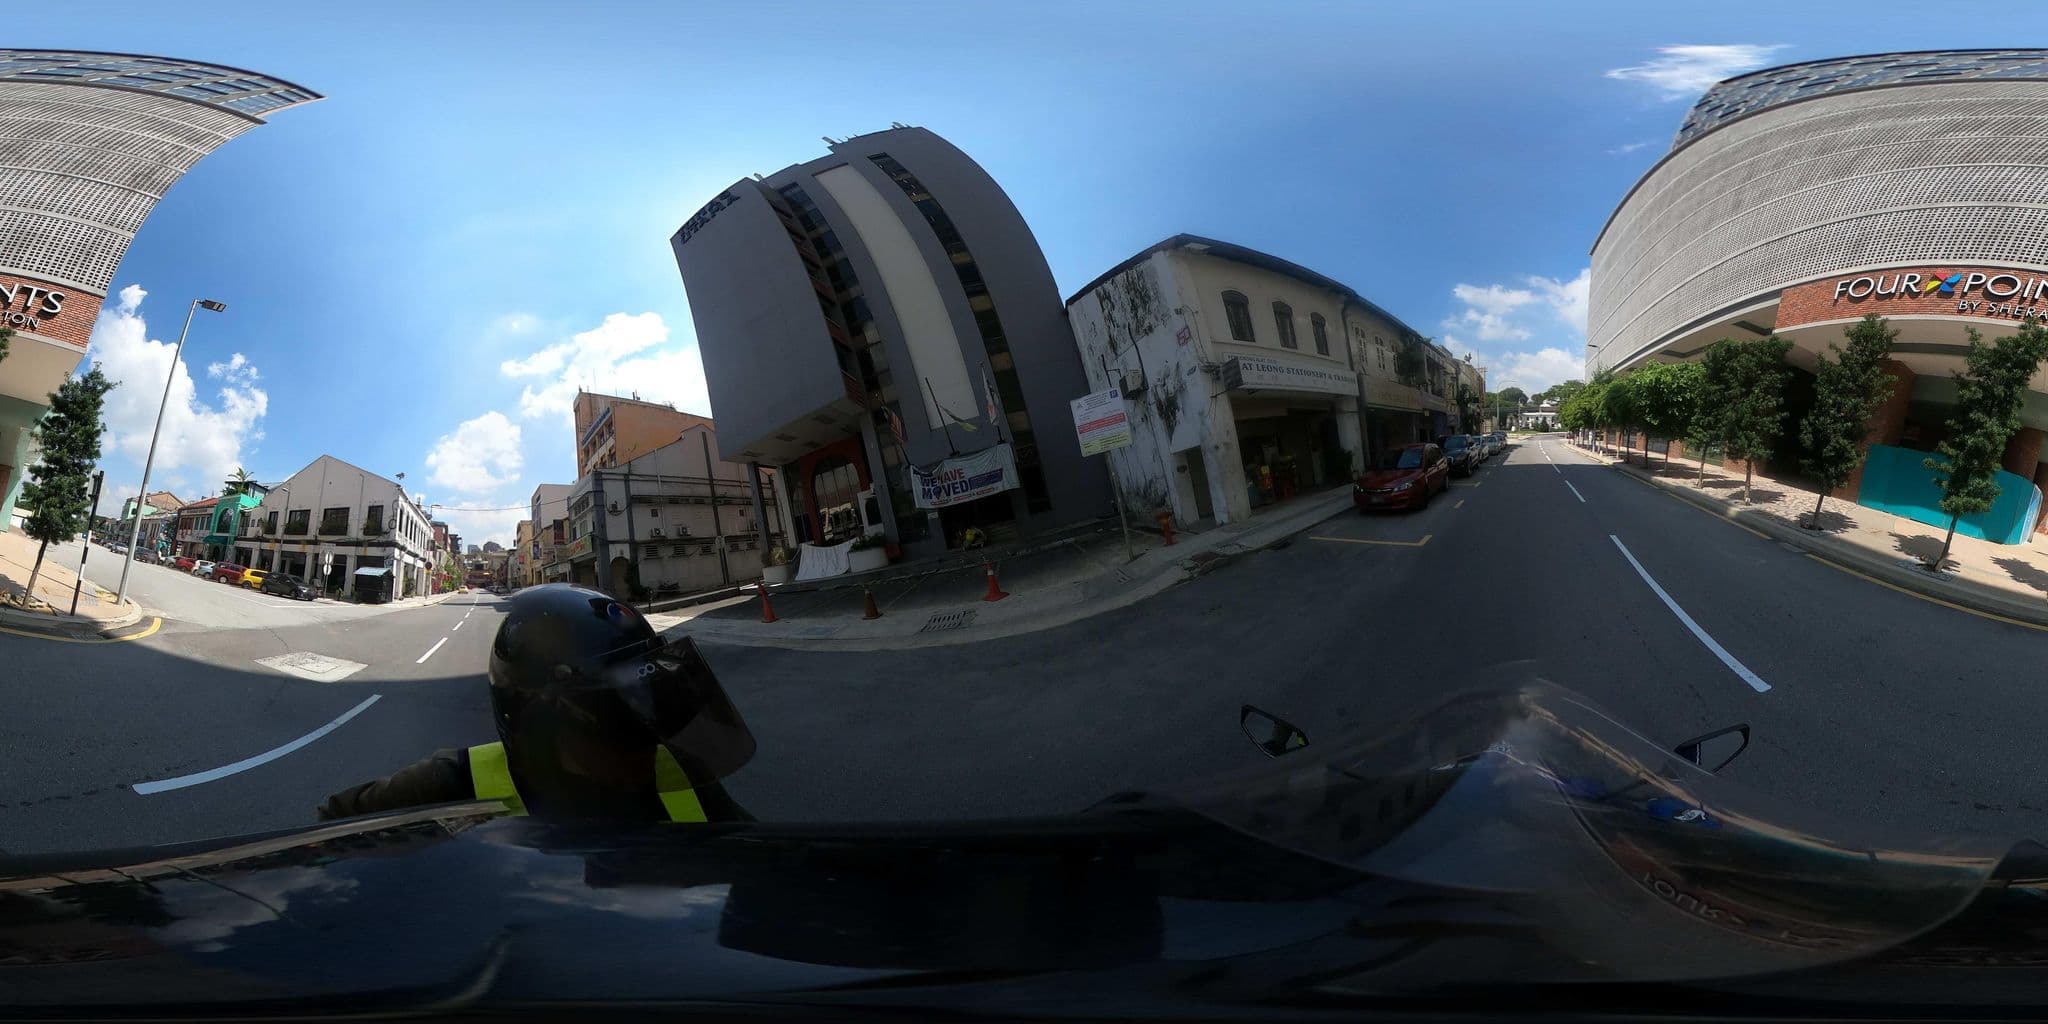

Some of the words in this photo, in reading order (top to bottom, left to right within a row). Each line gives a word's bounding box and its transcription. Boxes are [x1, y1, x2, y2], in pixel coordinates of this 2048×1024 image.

[1834, 273, 1921, 299] FOUR
[1958, 299, 1982, 311] BY
[4, 311, 40, 329] TON
[920, 476, 937, 487] WE
